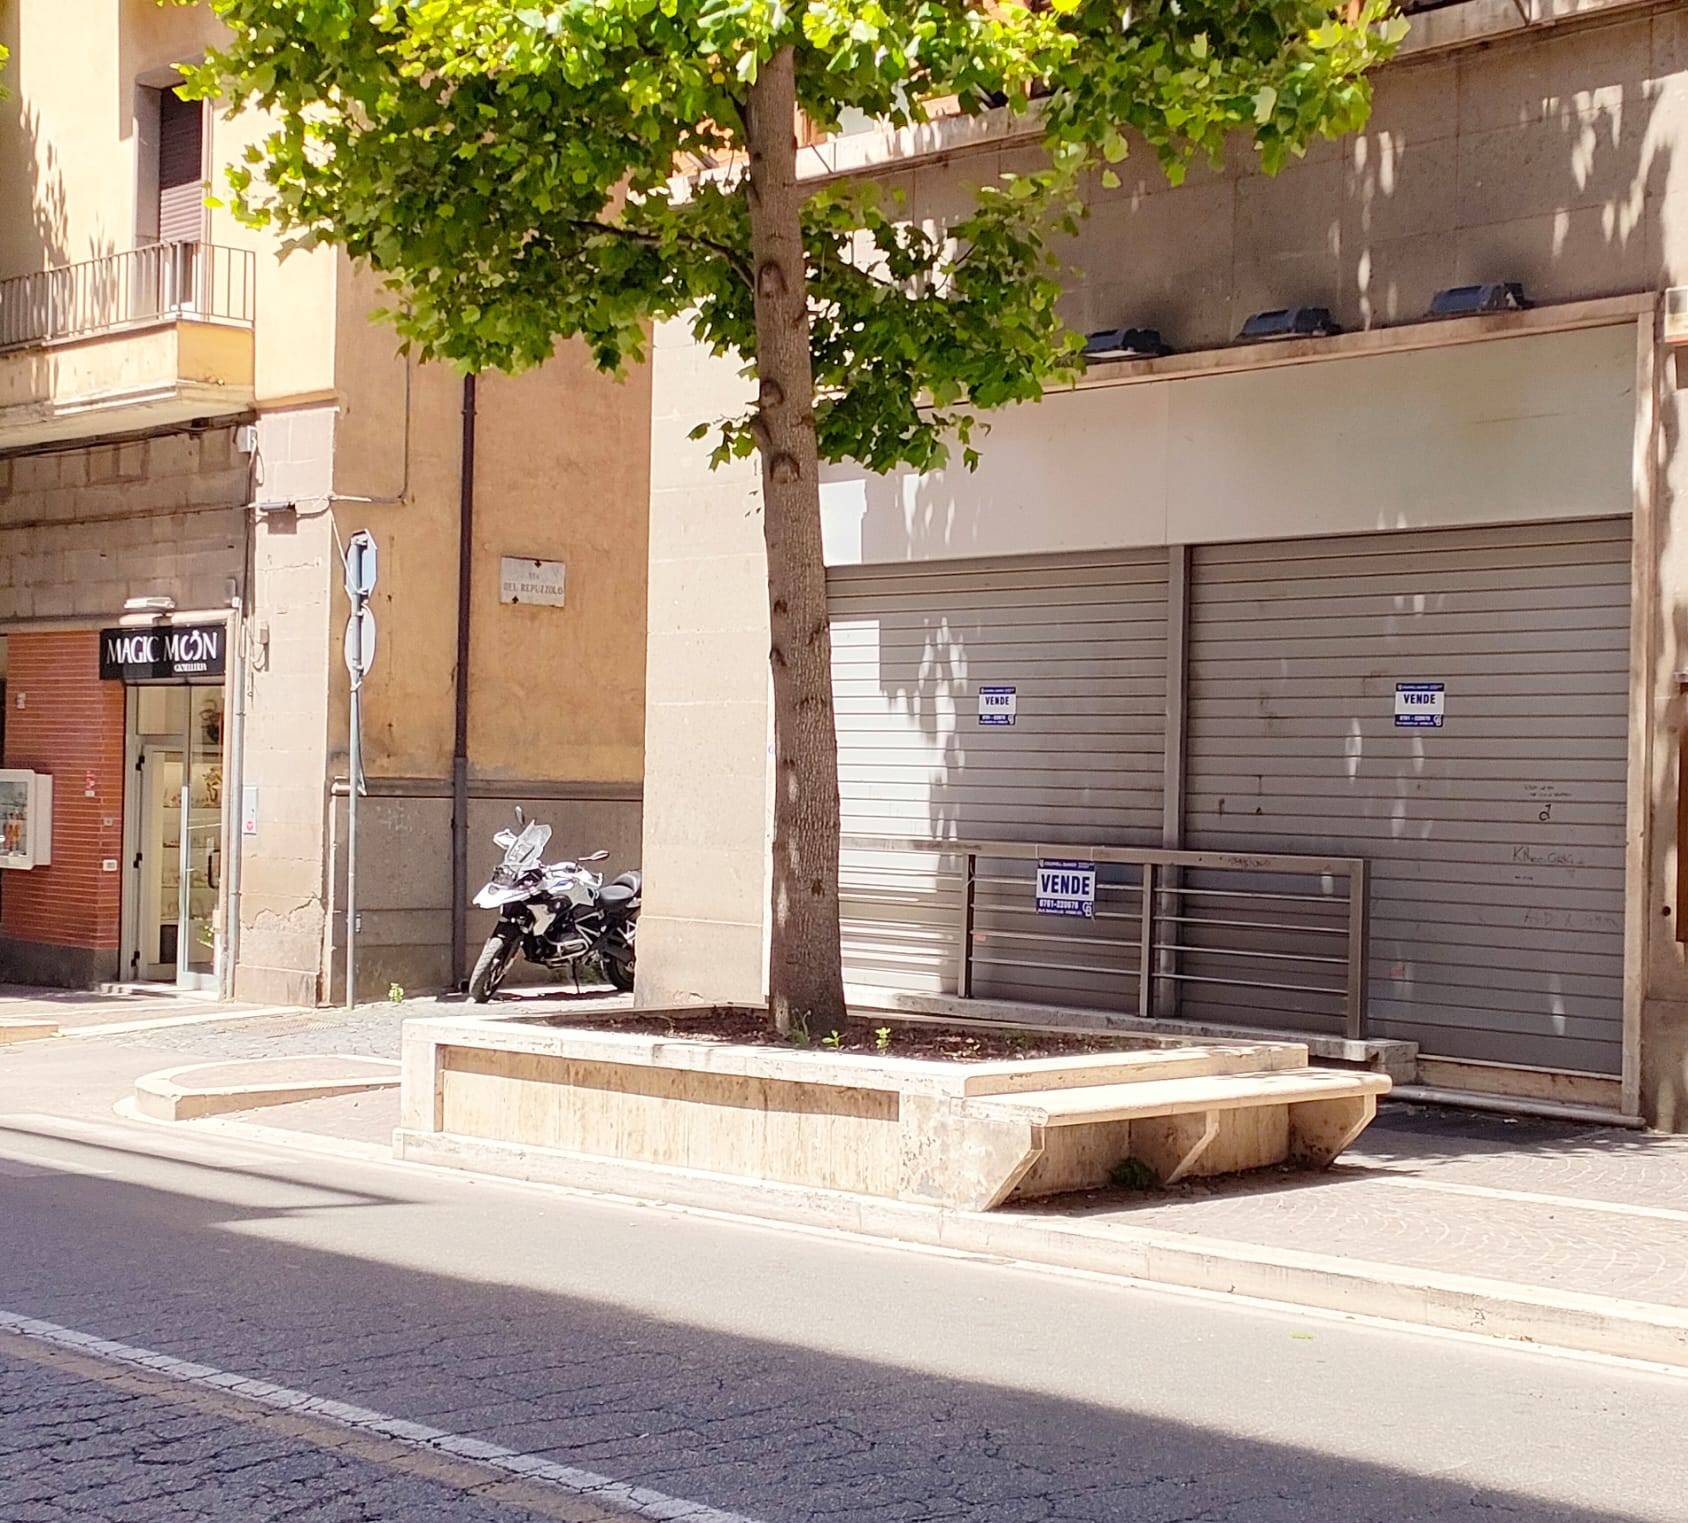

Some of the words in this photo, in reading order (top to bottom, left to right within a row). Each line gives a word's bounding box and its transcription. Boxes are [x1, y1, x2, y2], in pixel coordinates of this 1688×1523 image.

[106, 635, 159, 665] MAGIC
[163, 630, 218, 662] MOON
[985, 696, 1009, 705] VENDE
[1404, 694, 1436, 704] VENDE
[1041, 874, 1090, 895] VENDE
